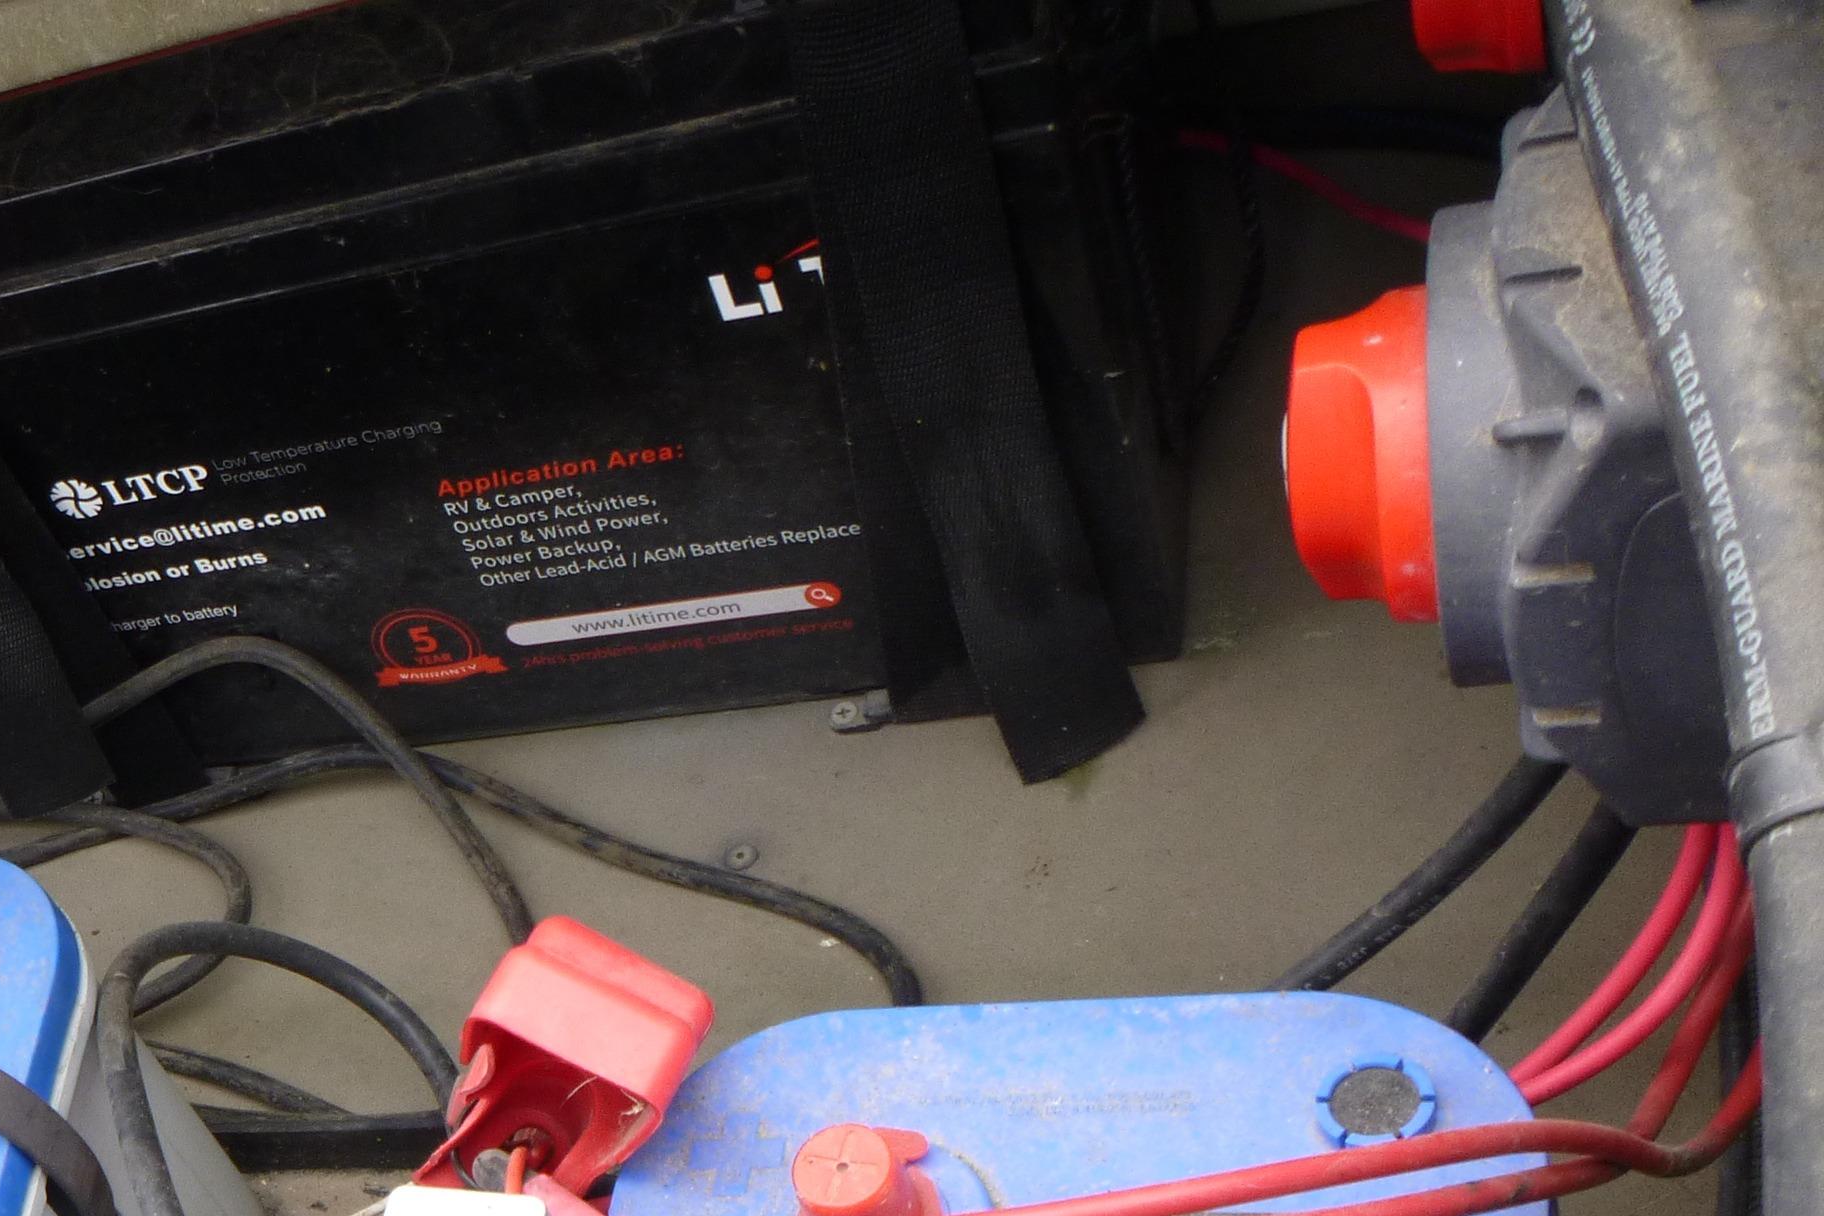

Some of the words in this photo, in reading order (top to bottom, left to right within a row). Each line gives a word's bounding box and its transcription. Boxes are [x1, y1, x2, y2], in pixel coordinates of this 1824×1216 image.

[1673, 331, 1711, 416] FUEL
[102, 463, 208, 506] LTCP
[212, 455, 248, 472] Low
[249, 434, 359, 466] Temperature
[361, 421, 443, 445] Charging
[221, 459, 308, 486] Protection
[438, 457, 597, 498] Application
[606, 444, 685, 470] Area:
[1687, 409, 1736, 536] MARINE
[444, 502, 470, 517] RV
[475, 498, 491, 512] &
[495, 483, 583, 511] Camper,
[453, 510, 549, 535] Outdoors
[554, 493, 657, 520] Activities,
[66, 502, 327, 561] ervice@litime.com
[463, 535, 517, 553] Solar
[520, 531, 535, 543] &
[538, 522, 591, 542] Wind
[597, 511, 669, 533] Power,
[166, 563, 190, 580] or
[194, 551, 269, 576] Burns
[471, 549, 533, 571] Power
[539, 539, 623, 564] Backup,
[480, 568, 531, 588] Other
[537, 554, 627, 580] Lead-Acid
[644, 544, 686, 565] AGM
[690, 531, 777, 556] Batteries
[782, 522, 862, 549] Replace
[164, 613, 181, 625] to
[182, 604, 239, 624] battery
[571, 601, 741, 636] www.litime.com
[409, 625, 438, 655] 5
[1721, 538, 1776, 739] ERM-GUARD
[400, 662, 478, 681] WARRANTY
[415, 650, 451, 666] YEAR
